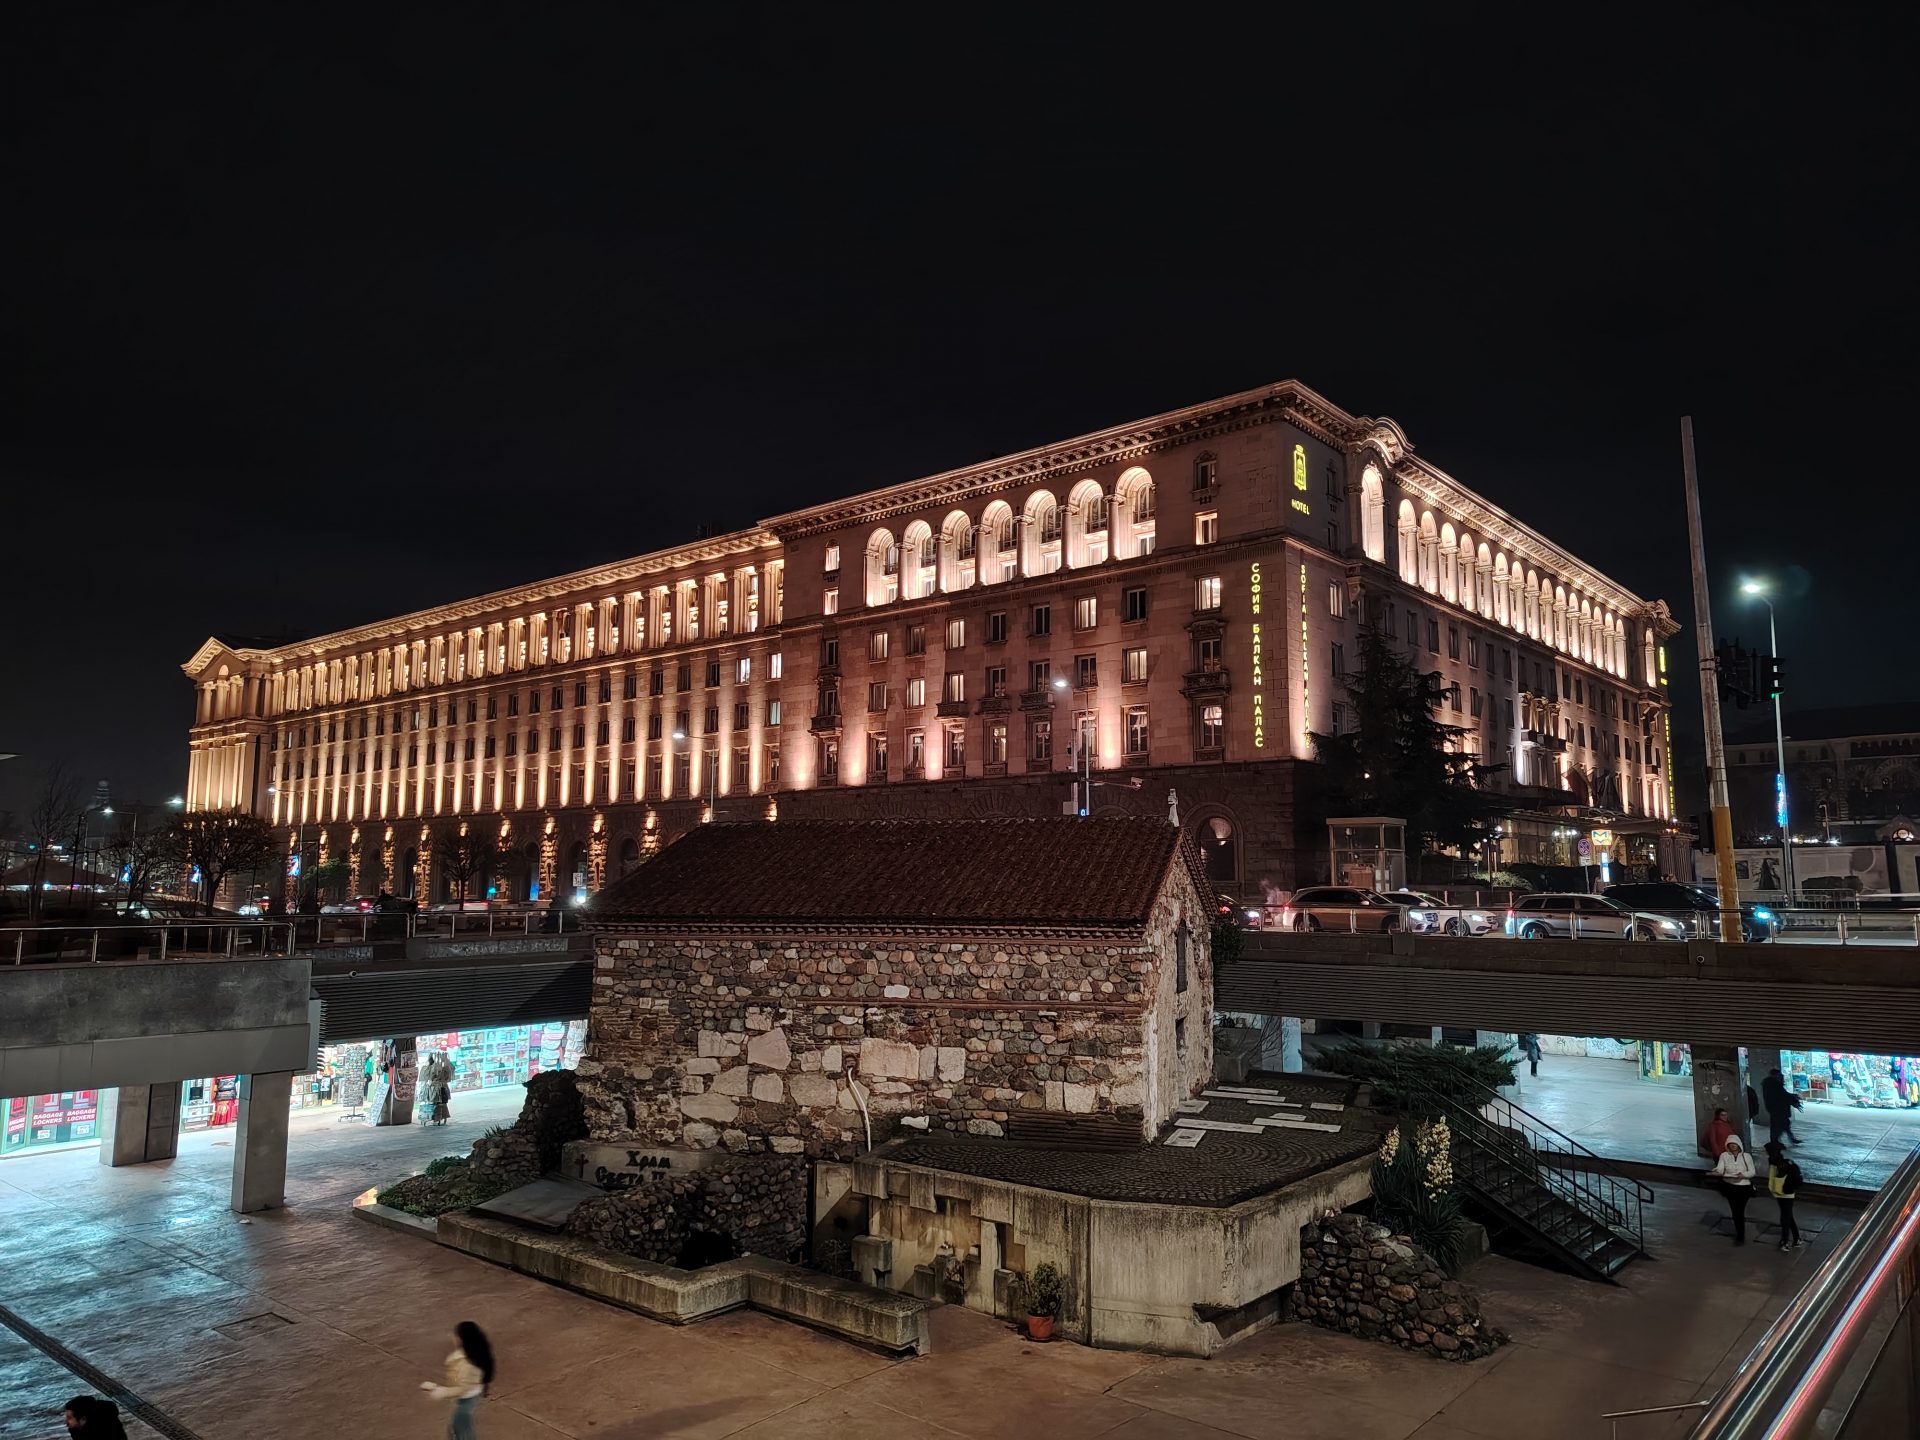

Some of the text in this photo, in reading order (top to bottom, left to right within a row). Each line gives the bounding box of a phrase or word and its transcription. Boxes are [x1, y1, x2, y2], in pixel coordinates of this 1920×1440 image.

[1291, 498, 1310, 515] HOTEL
[1251, 562, 1263, 748] СОФИЯ БАЛКАН ПАЛАС
[33, 1112, 64, 1120] BAGGAGE
[67, 1108, 96, 1116] BAGGAGE
[33, 1117, 62, 1126] LOCKERS
[67, 1113, 95, 1122] LOCKERS
